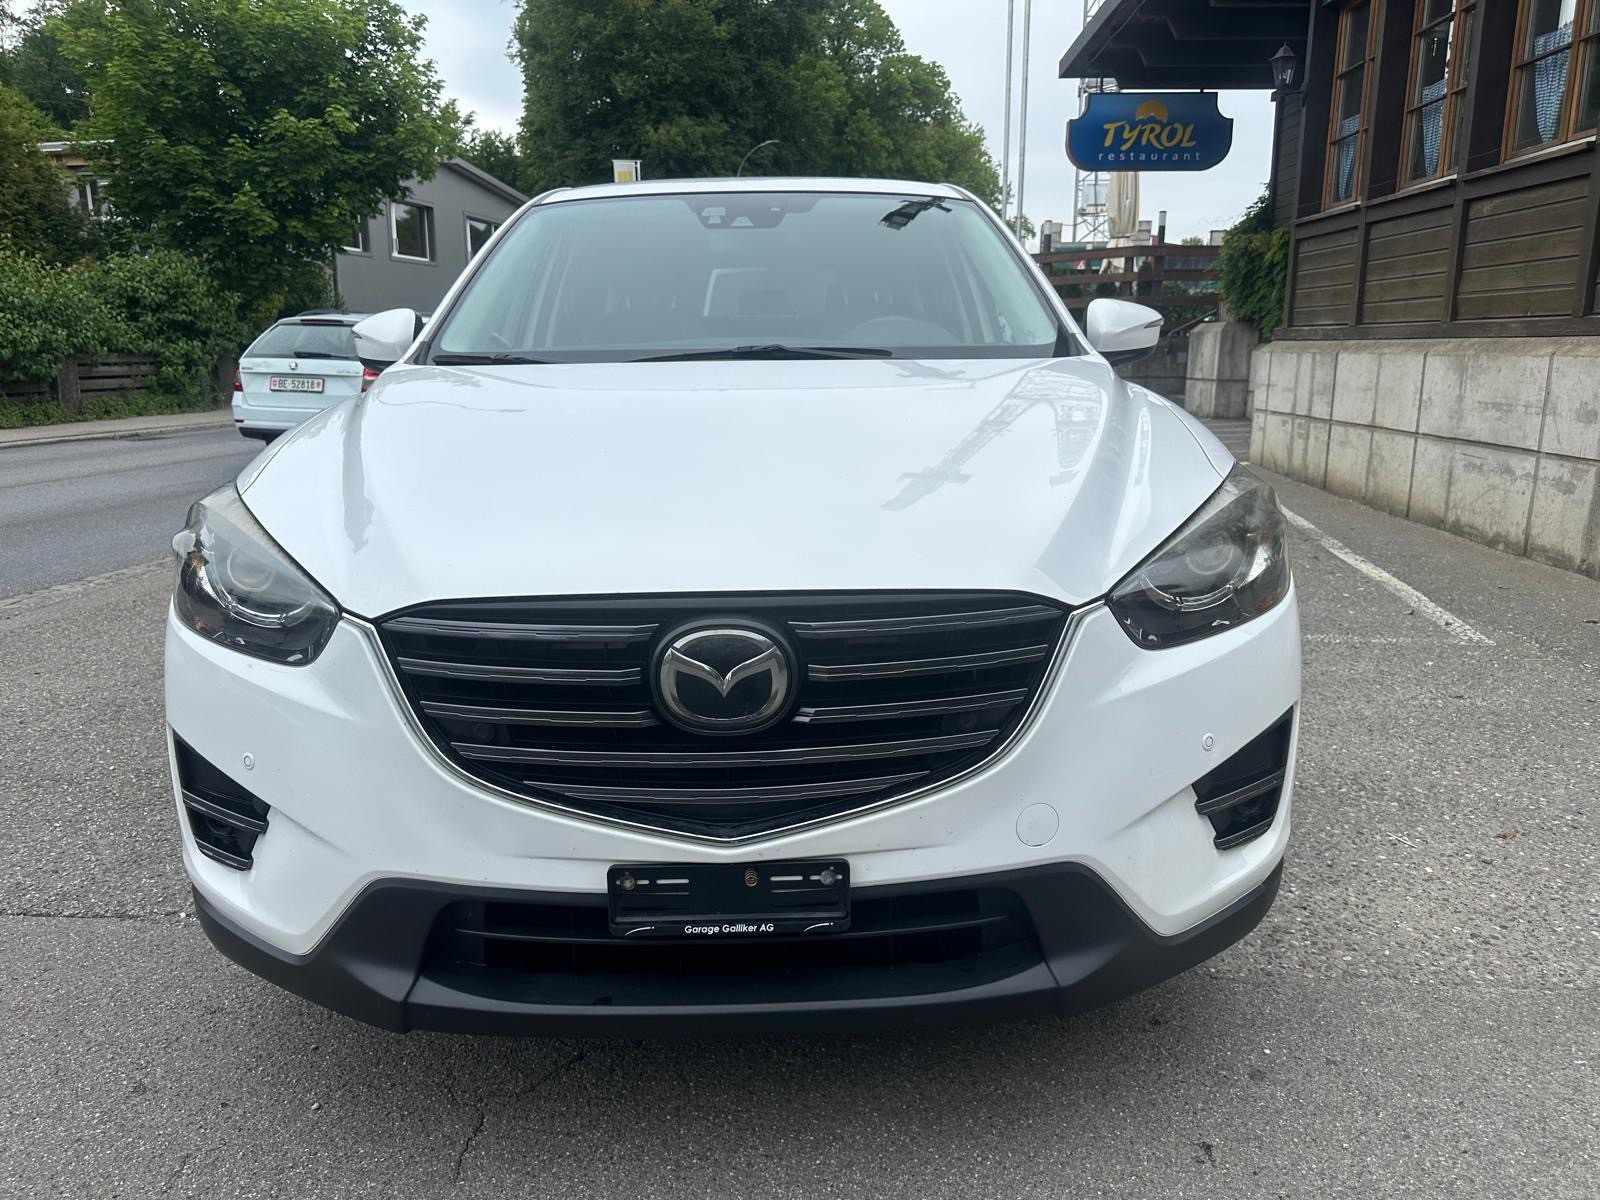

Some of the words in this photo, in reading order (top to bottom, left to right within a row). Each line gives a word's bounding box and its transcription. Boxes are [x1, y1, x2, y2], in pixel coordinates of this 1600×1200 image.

[1103, 120, 1197, 151] TYROL
[1098, 151, 1201, 161] restaurant
[684, 925, 720, 935] Garage
[722, 924, 758, 933] Galliker
[759, 923, 774, 932] AG
